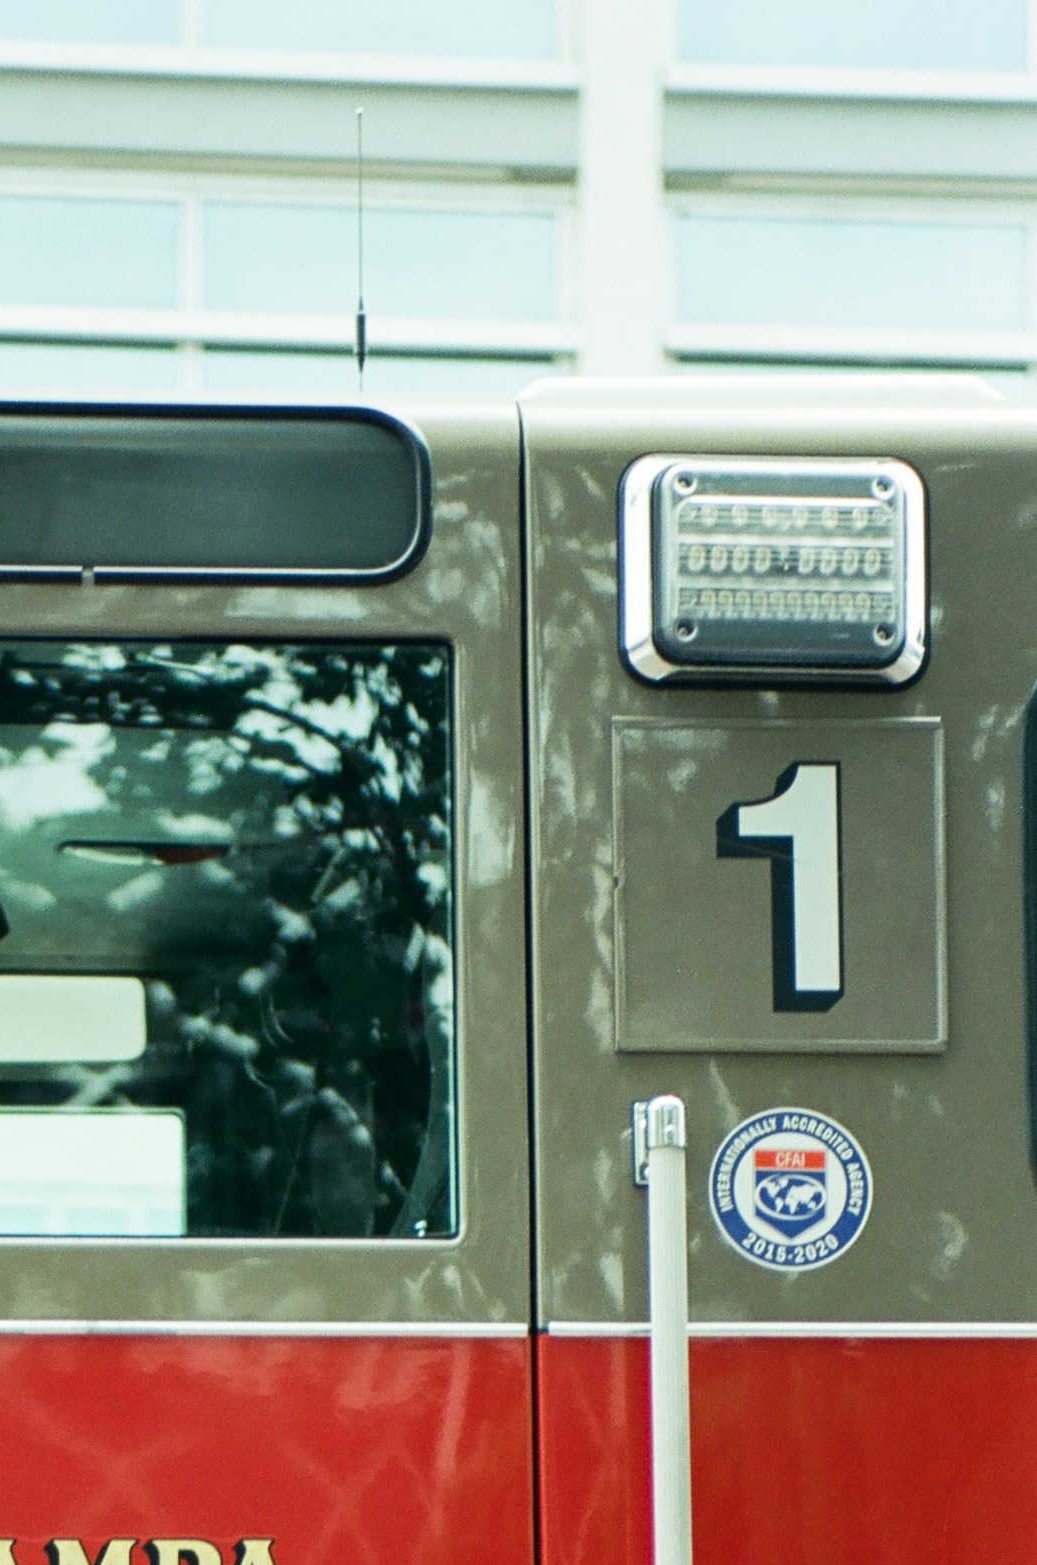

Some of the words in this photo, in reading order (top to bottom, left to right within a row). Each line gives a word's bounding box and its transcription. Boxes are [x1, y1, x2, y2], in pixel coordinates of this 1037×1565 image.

[717, 761, 844, 1012] 1
[717, 1116, 777, 1213] INTERNATIONALLY
[782, 1115, 854, 1162] ACCREDITED
[846, 1162, 864, 1217] AGENCY
[776, 1152, 806, 1168] CFAI
